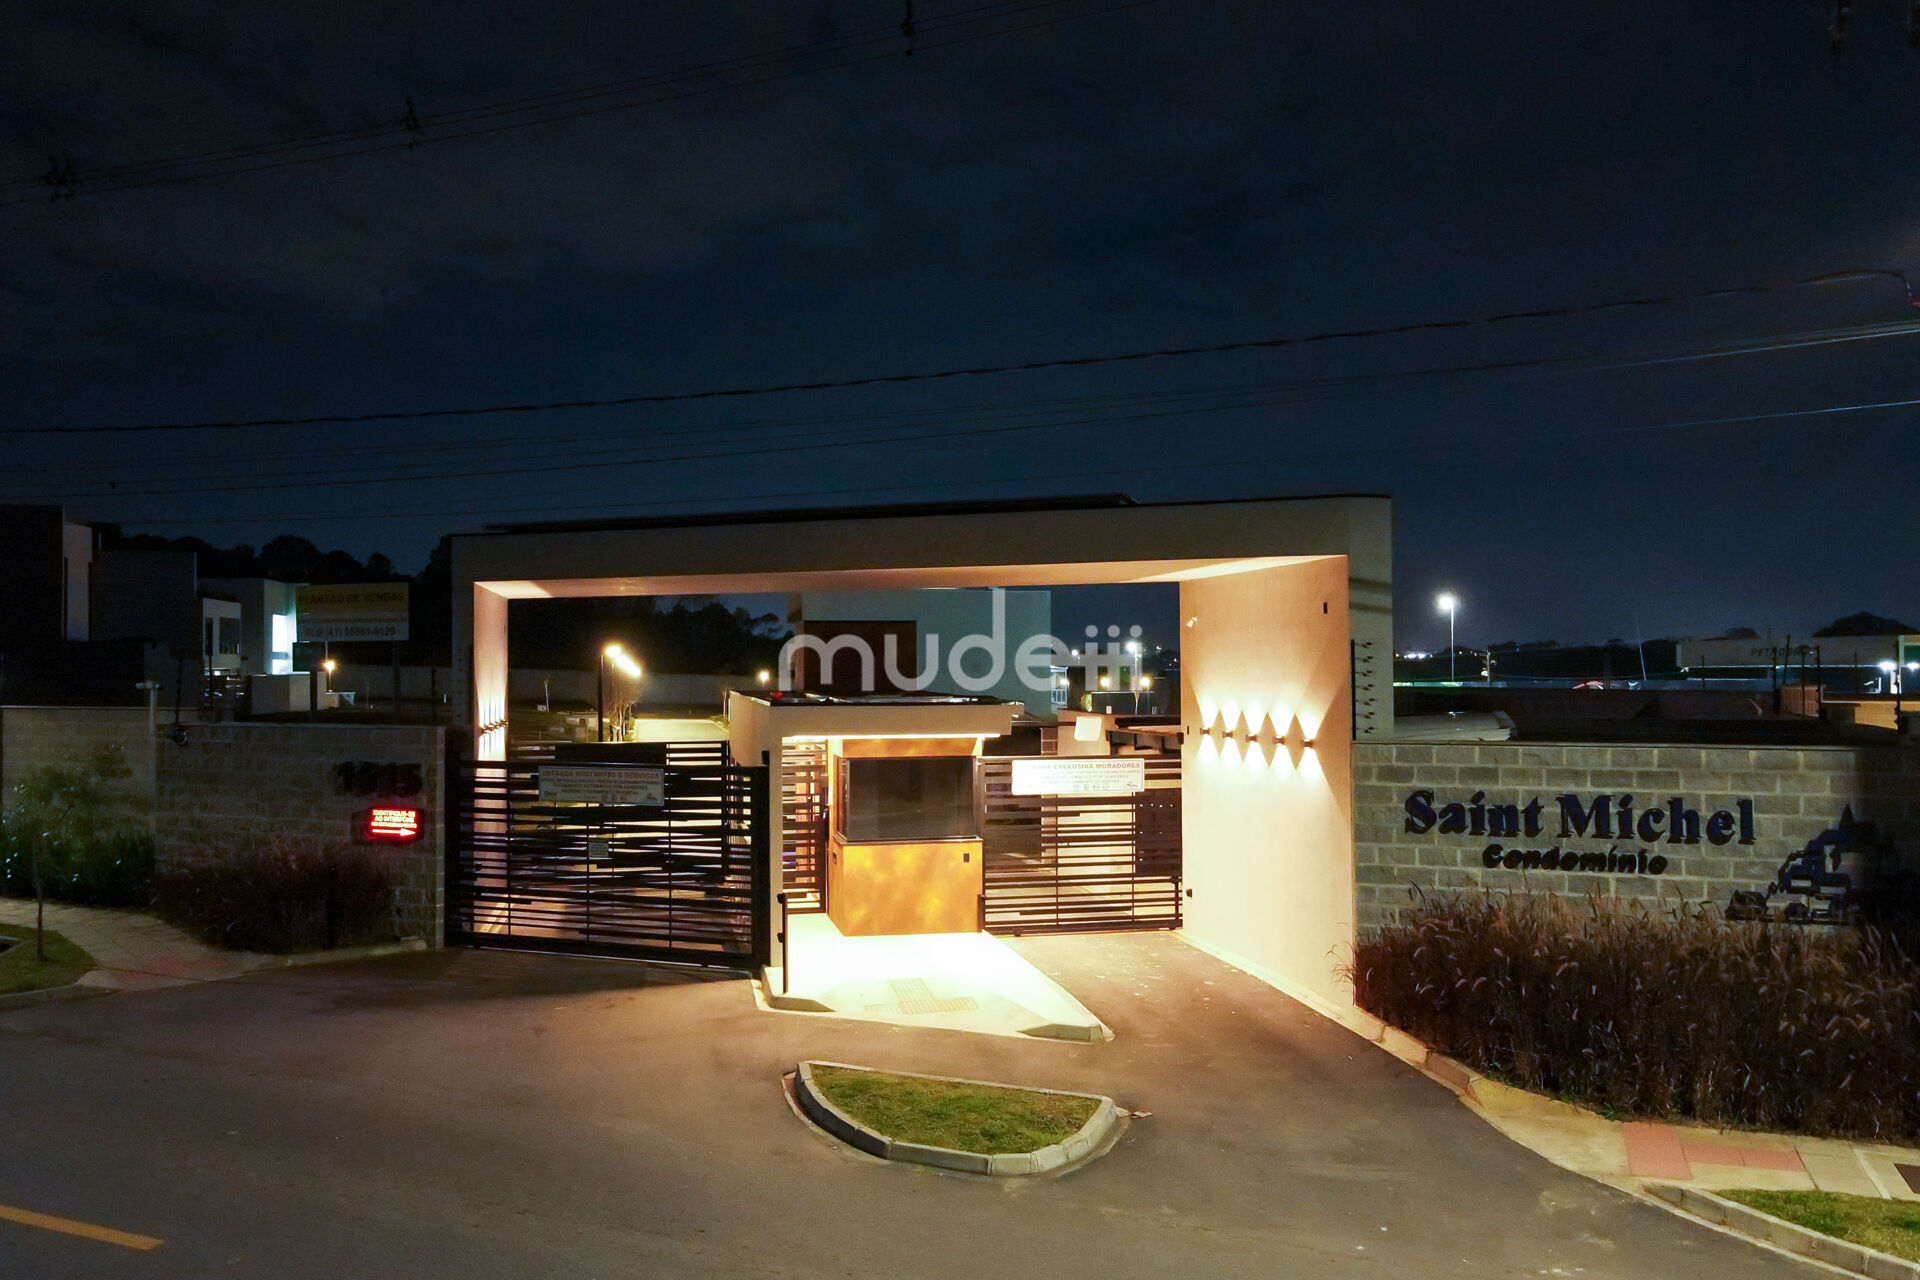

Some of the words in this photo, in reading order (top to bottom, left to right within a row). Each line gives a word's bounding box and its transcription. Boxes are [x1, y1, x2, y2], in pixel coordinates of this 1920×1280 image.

[1405, 789, 1545, 838] Saint
[1557, 793, 1755, 846] Michel
[1482, 843, 1668, 875] Condomínio
